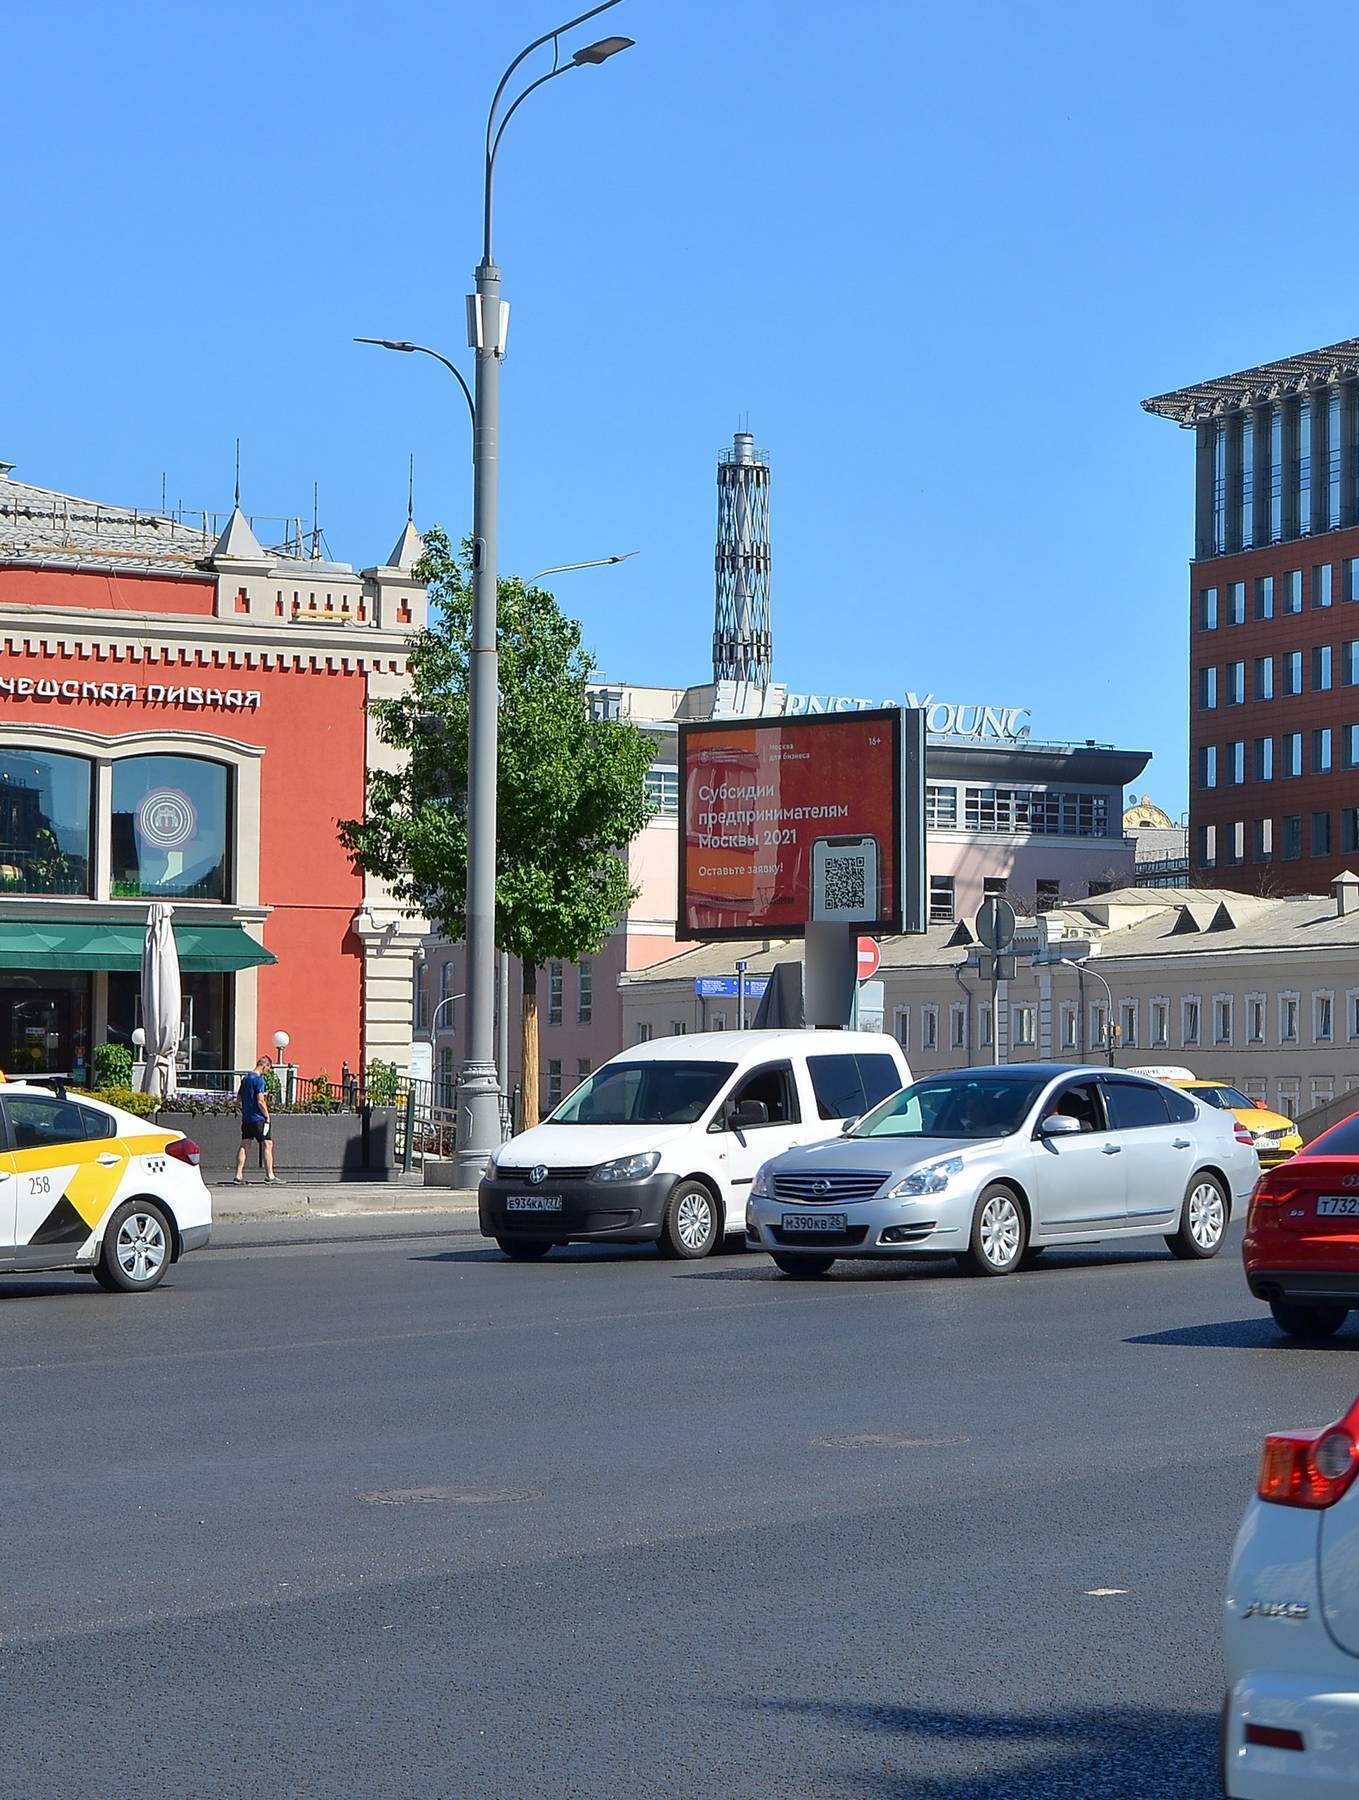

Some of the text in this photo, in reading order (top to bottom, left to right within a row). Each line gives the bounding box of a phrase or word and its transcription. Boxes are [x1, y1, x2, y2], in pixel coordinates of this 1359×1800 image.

[146, 684, 261, 707] ПИВНАЯ
[868, 736, 881, 746] 16+
[782, 751, 810, 761] бизнеса
[698, 784, 774, 804] Субсидии
[698, 804, 849, 826] предпринимателям
[698, 828, 798, 849] Москвы 2021
[698, 861, 784, 877] Оставьте заявку!
[29, 1175, 51, 1195] 258
